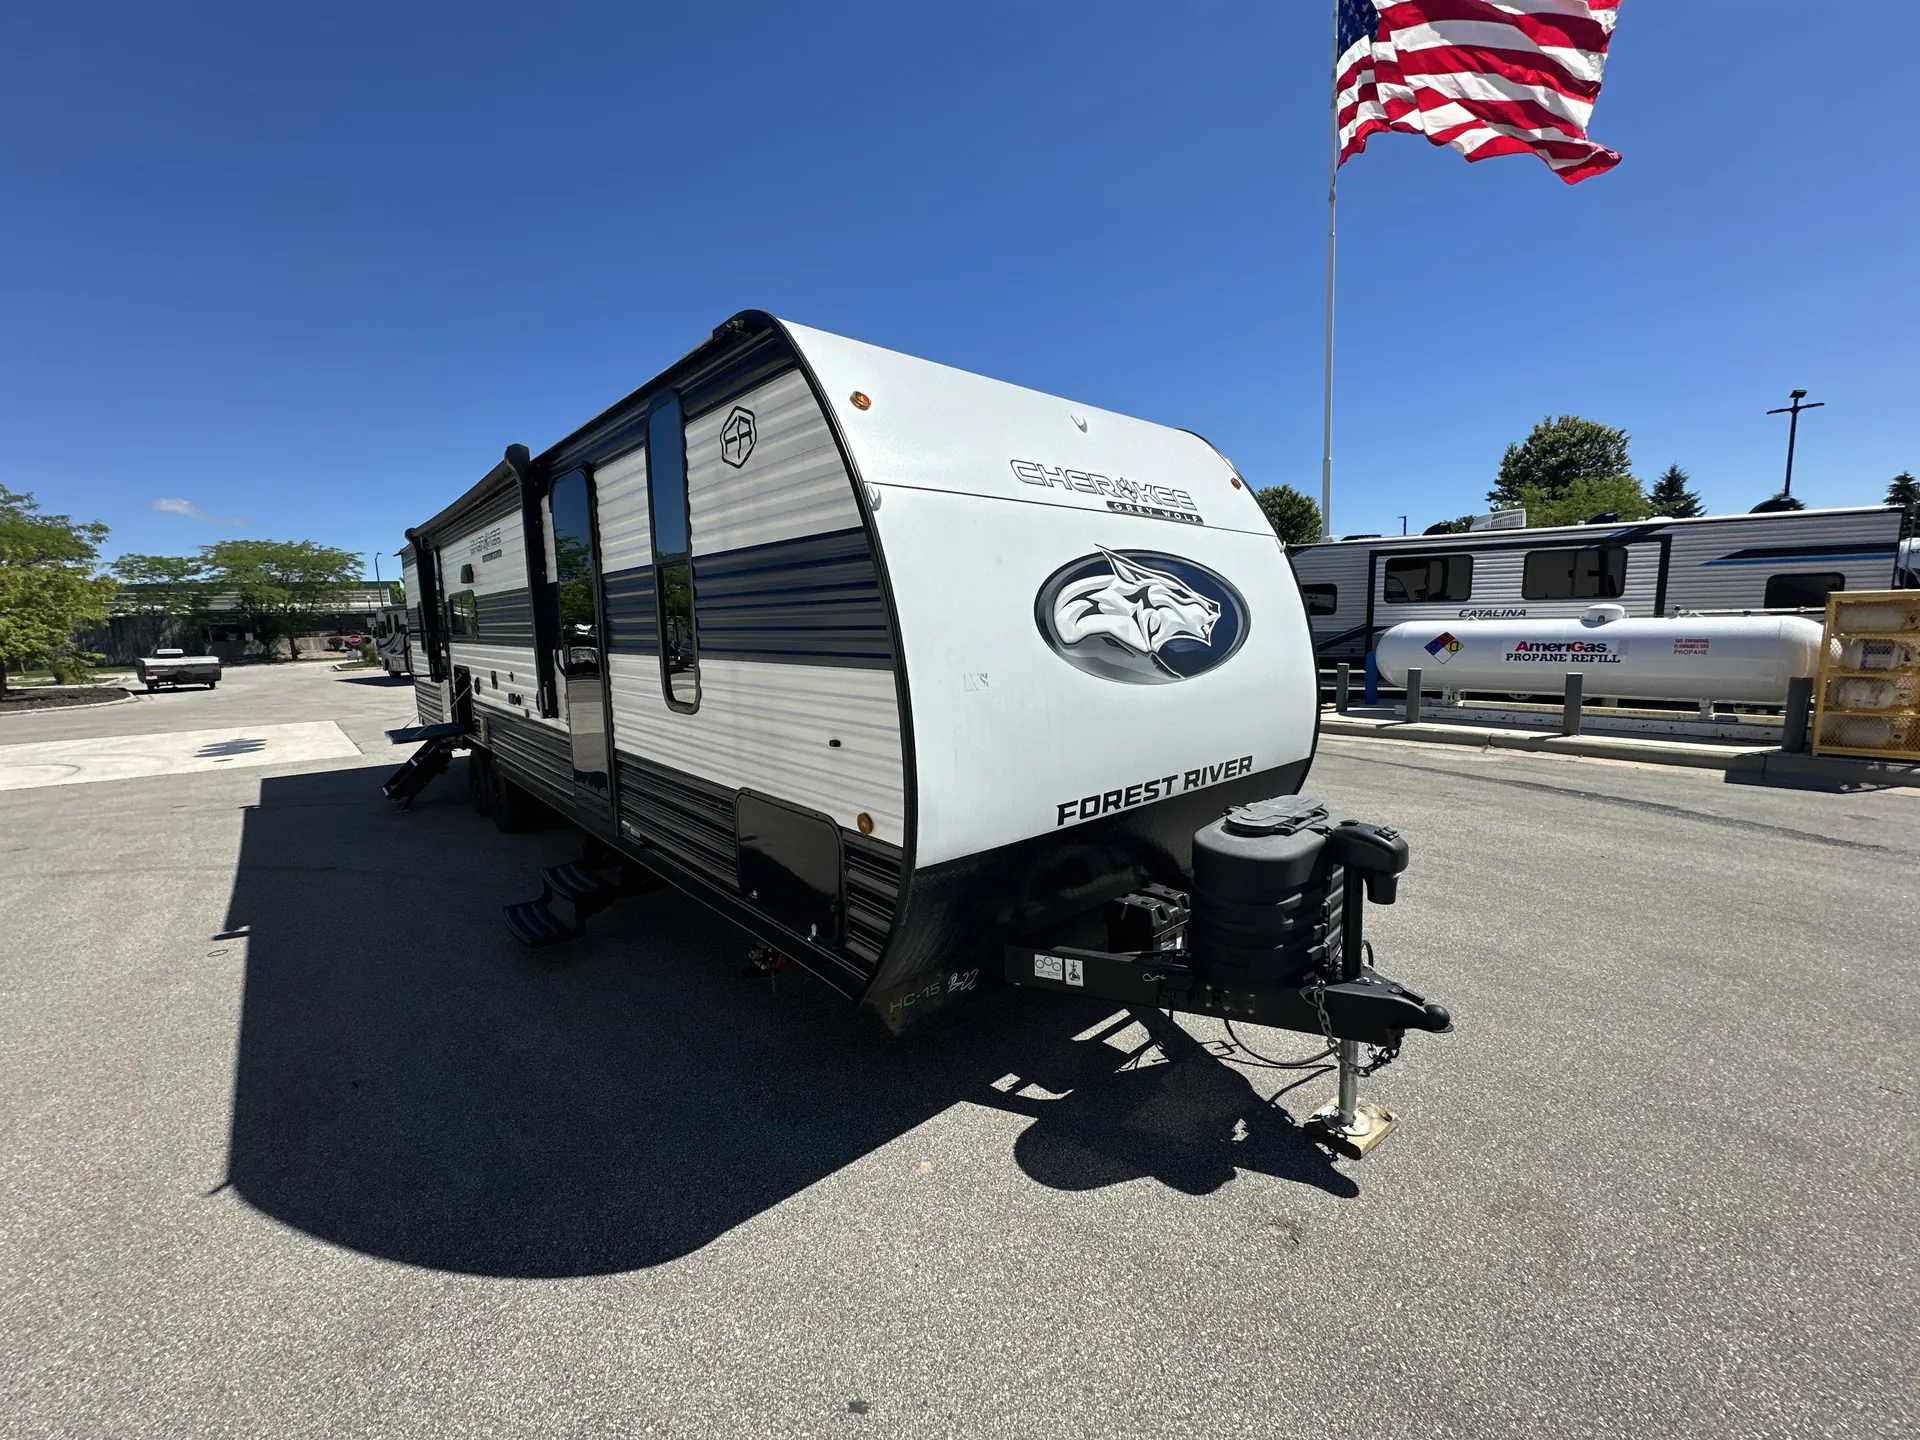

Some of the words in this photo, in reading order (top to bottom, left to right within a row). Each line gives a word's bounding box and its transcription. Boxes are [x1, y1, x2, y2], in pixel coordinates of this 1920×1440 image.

[1113, 502, 1154, 516] GREY
[1161, 510, 1200, 523] WOLF
[1458, 609, 1527, 618] CATALINA
[1449, 641, 1459, 652] 0
[1515, 640, 1608, 653] AmeriGas
[1506, 653, 1567, 662] PROPANE
[1570, 653, 1621, 663] REFILL
[1056, 774, 1179, 827] FOREST
[1183, 755, 1253, 791] RIVER
[889, 981, 941, 1014] HC-15
